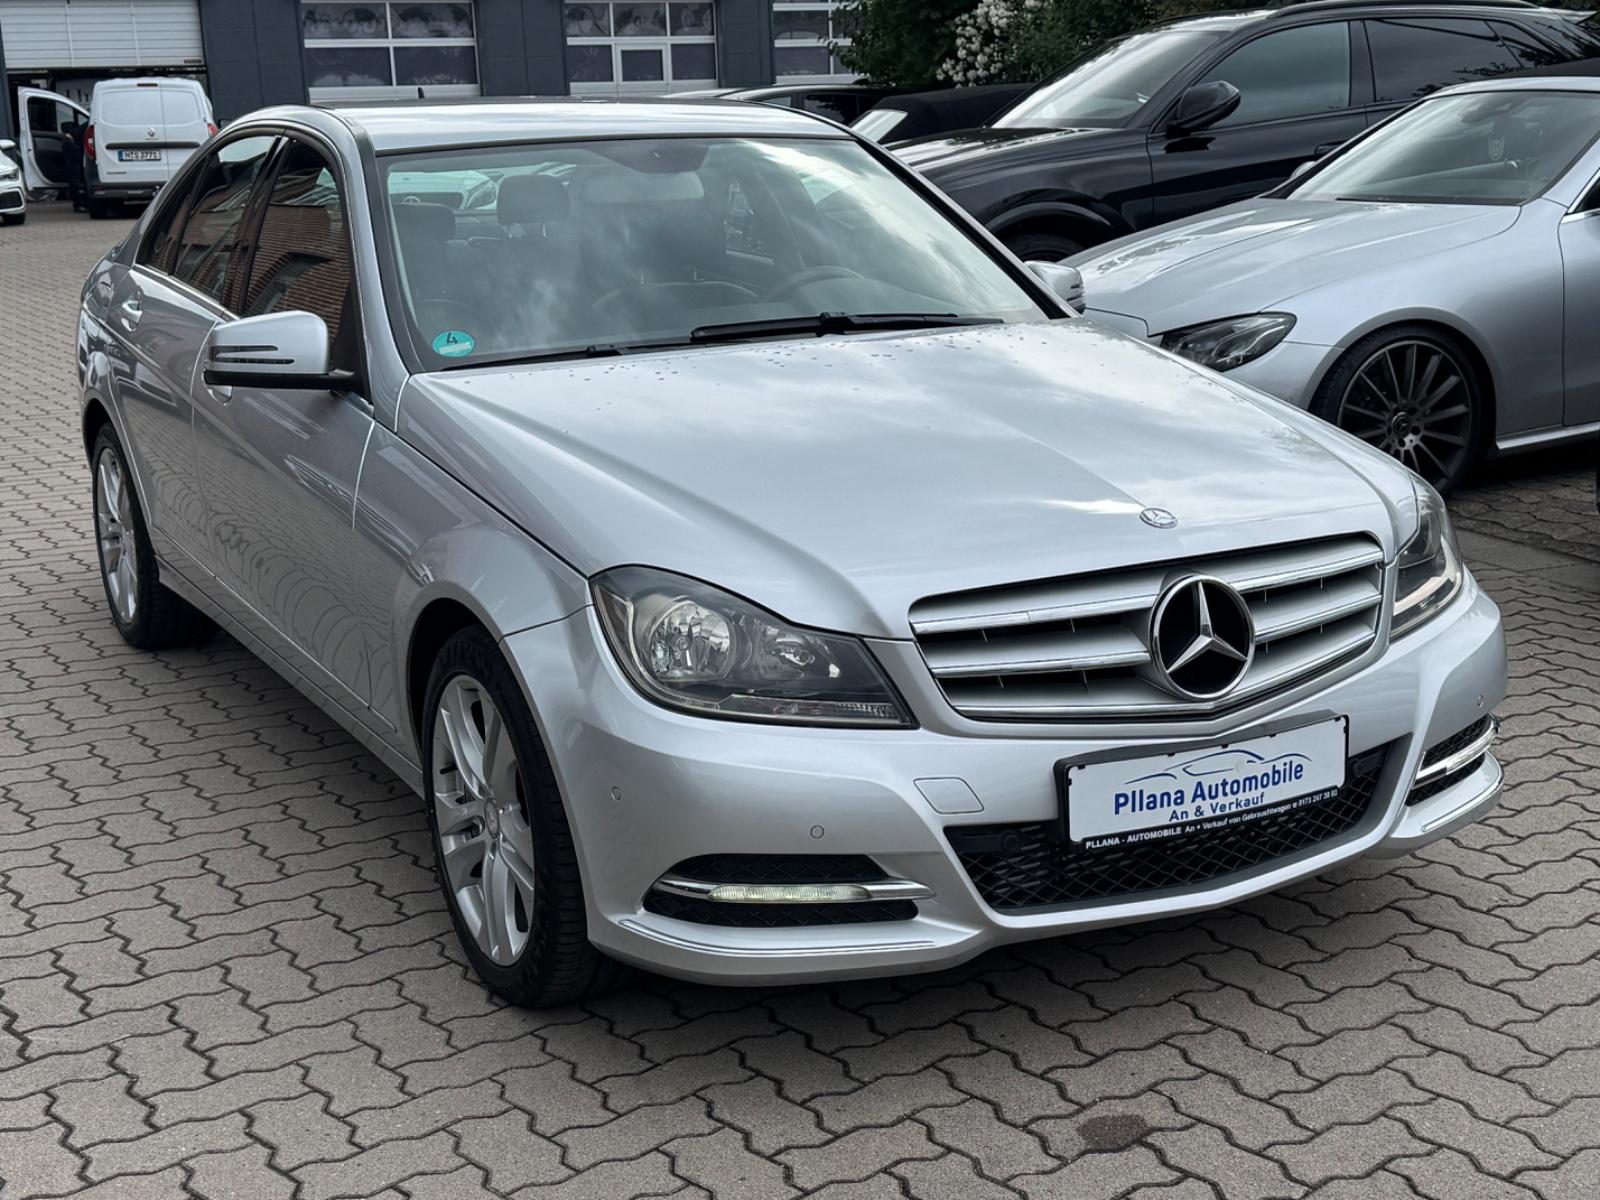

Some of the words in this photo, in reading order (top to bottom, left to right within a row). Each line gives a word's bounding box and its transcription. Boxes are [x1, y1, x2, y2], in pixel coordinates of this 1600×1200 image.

[1114, 789, 1185, 815] Pllana
[1191, 760, 1304, 803] Automobile
[1169, 810, 1189, 822] An
[1194, 807, 1205, 818] &
[1210, 792, 1265, 815] Verkauf
[1085, 837, 1120, 850] PLLANA
[1127, 827, 1182, 843] AUTOMOBILE
[1184, 825, 1195, 834] An
[1202, 817, 1228, 830] Verkauf
[1228, 816, 1241, 824] von
